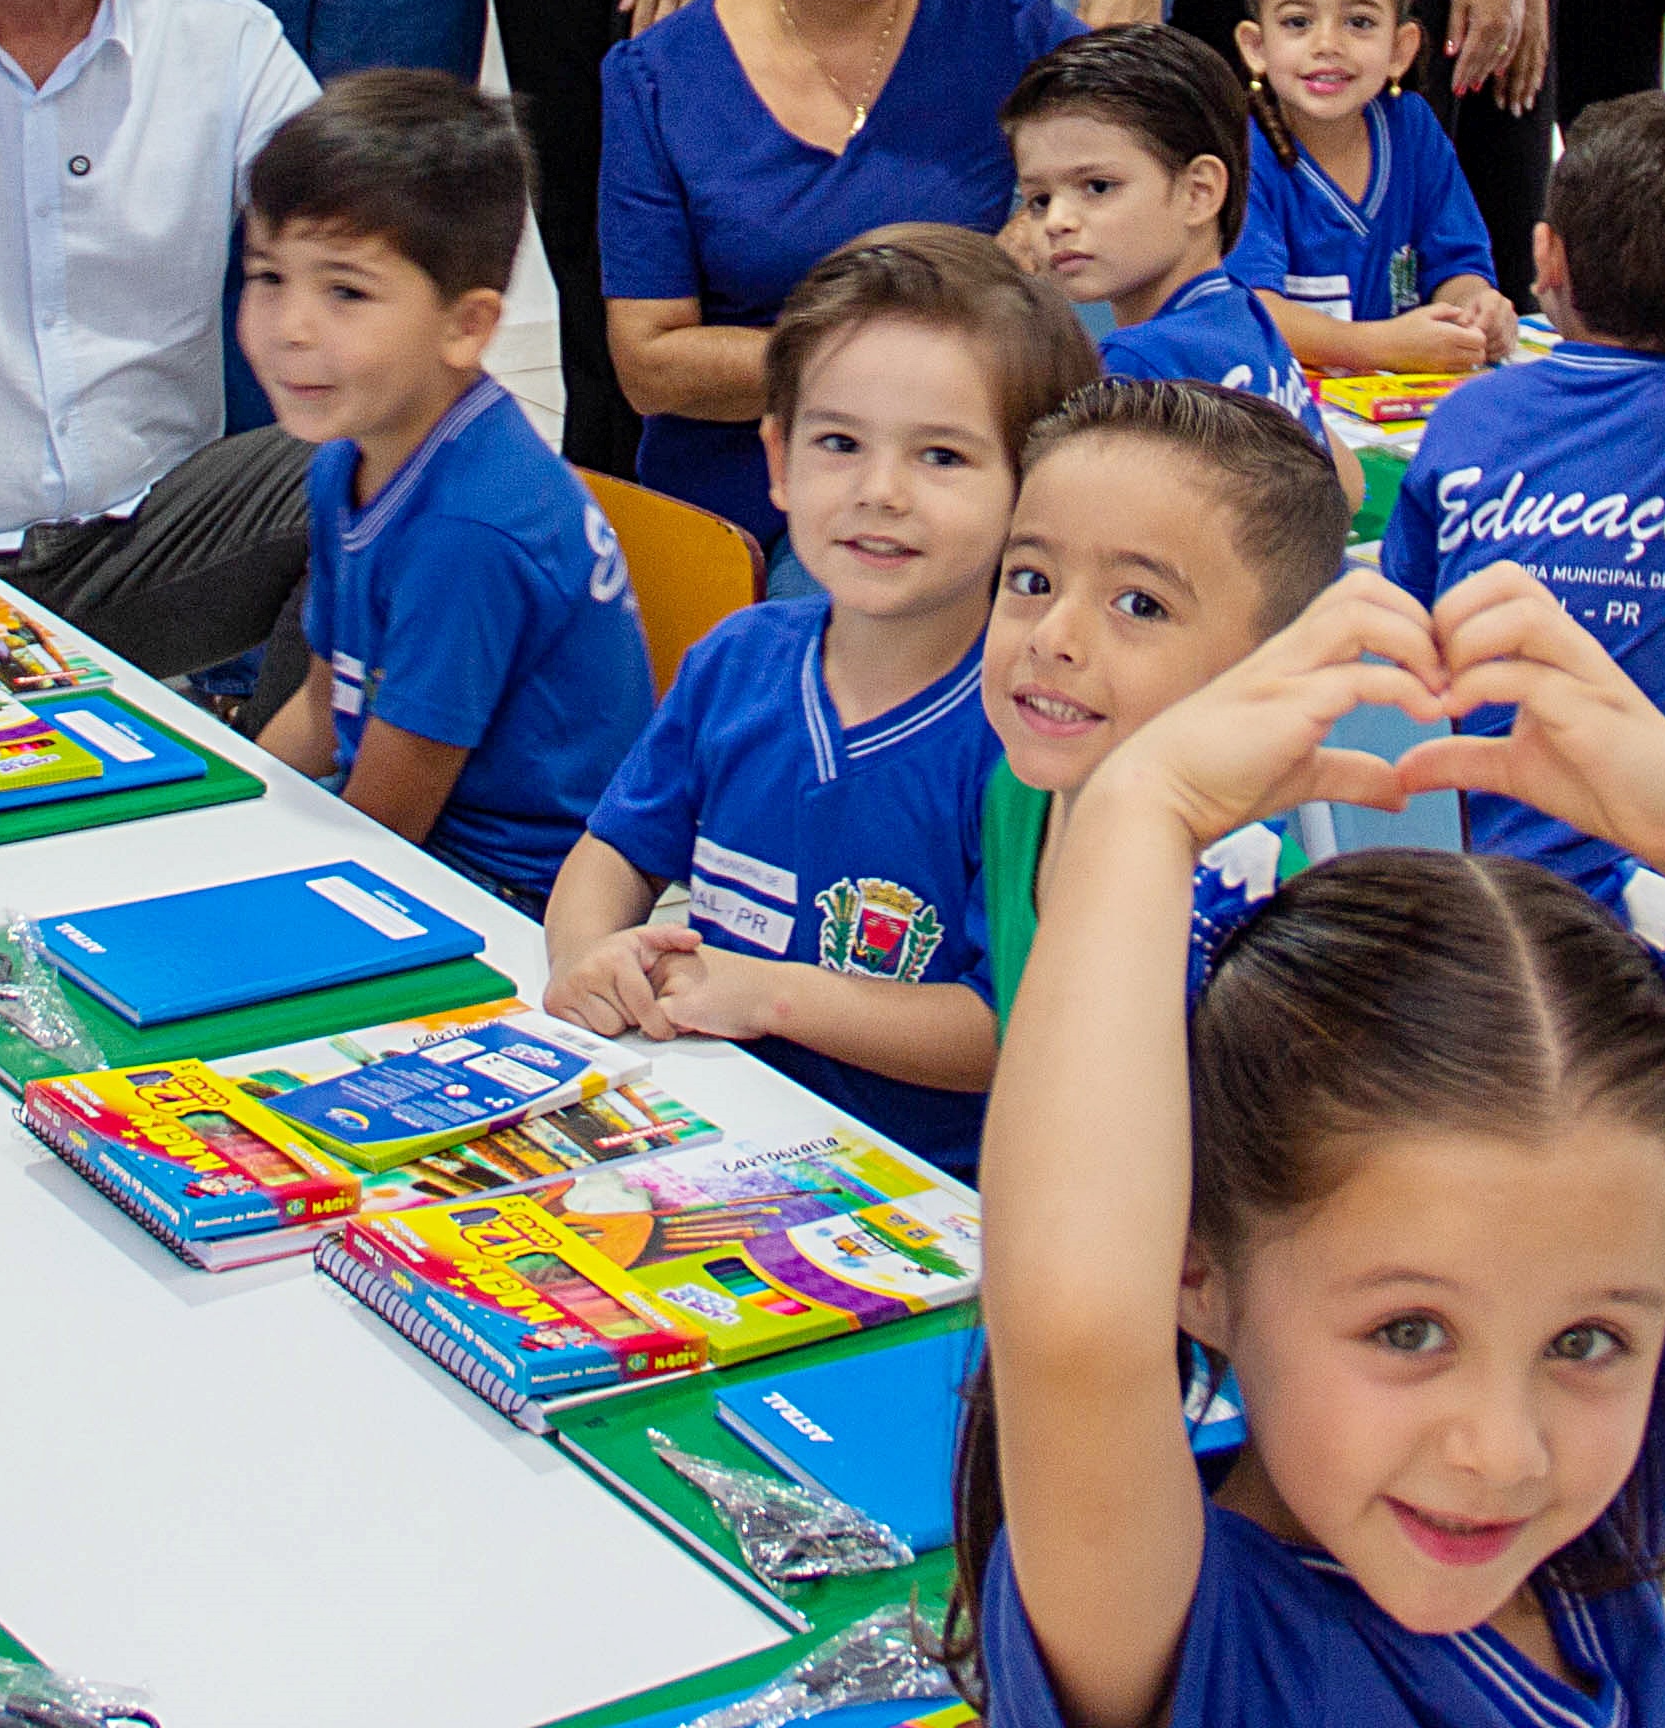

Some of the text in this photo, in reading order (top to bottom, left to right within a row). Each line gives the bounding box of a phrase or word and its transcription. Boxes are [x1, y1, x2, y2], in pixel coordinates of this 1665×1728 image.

[1552, 565, 1646, 588] MUNICIPAL
[1604, 599, 1641, 627] PR
[736, 907, 768, 934] PR
[54, 920, 108, 955] ASTRAL
[135, 1084, 200, 1114] 12
[722, 1135, 840, 1174] CARTOGRAFIA
[460, 1222, 530, 1261] 12
[761, 1391, 834, 1444] ASTRAL
